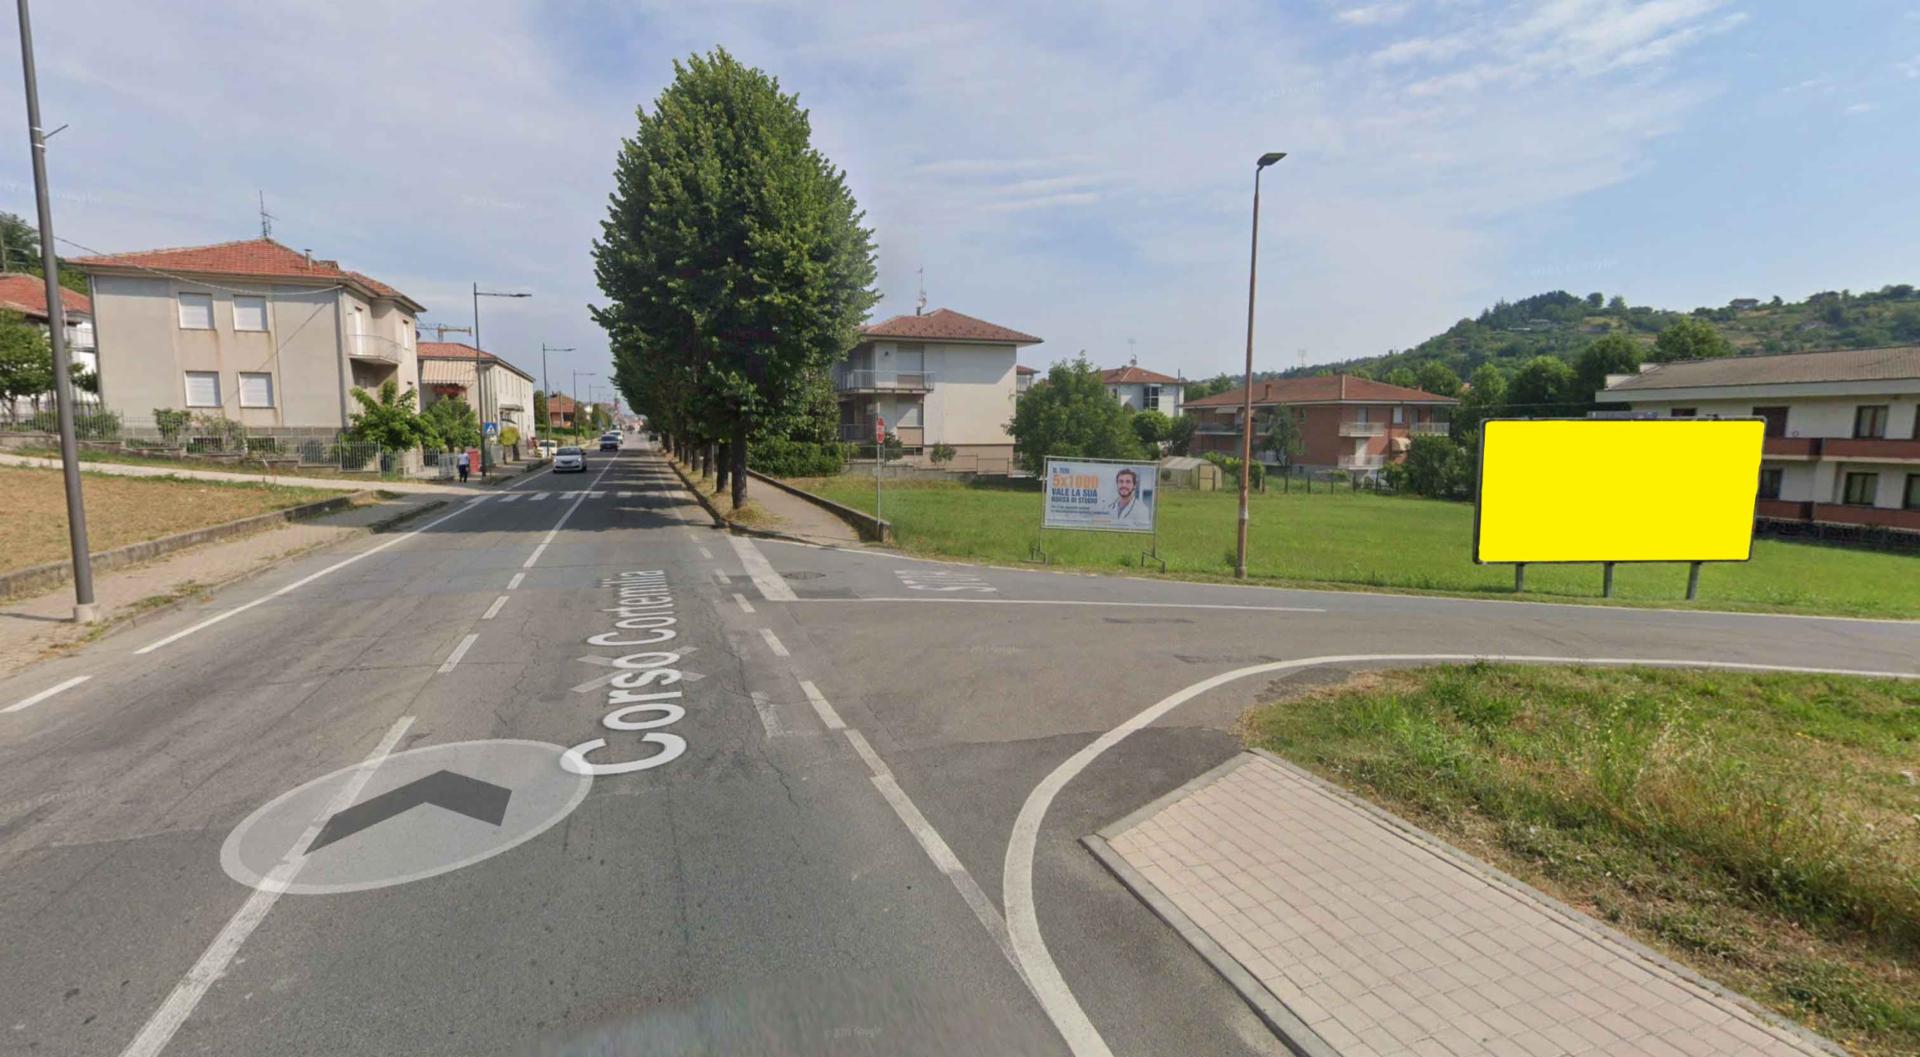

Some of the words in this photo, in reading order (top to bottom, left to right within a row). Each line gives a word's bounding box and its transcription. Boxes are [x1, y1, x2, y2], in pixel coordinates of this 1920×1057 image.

[1052, 488, 1069, 496] VALE
[1072, 488, 1081, 497] LA
[1083, 489, 1098, 497] SUA
